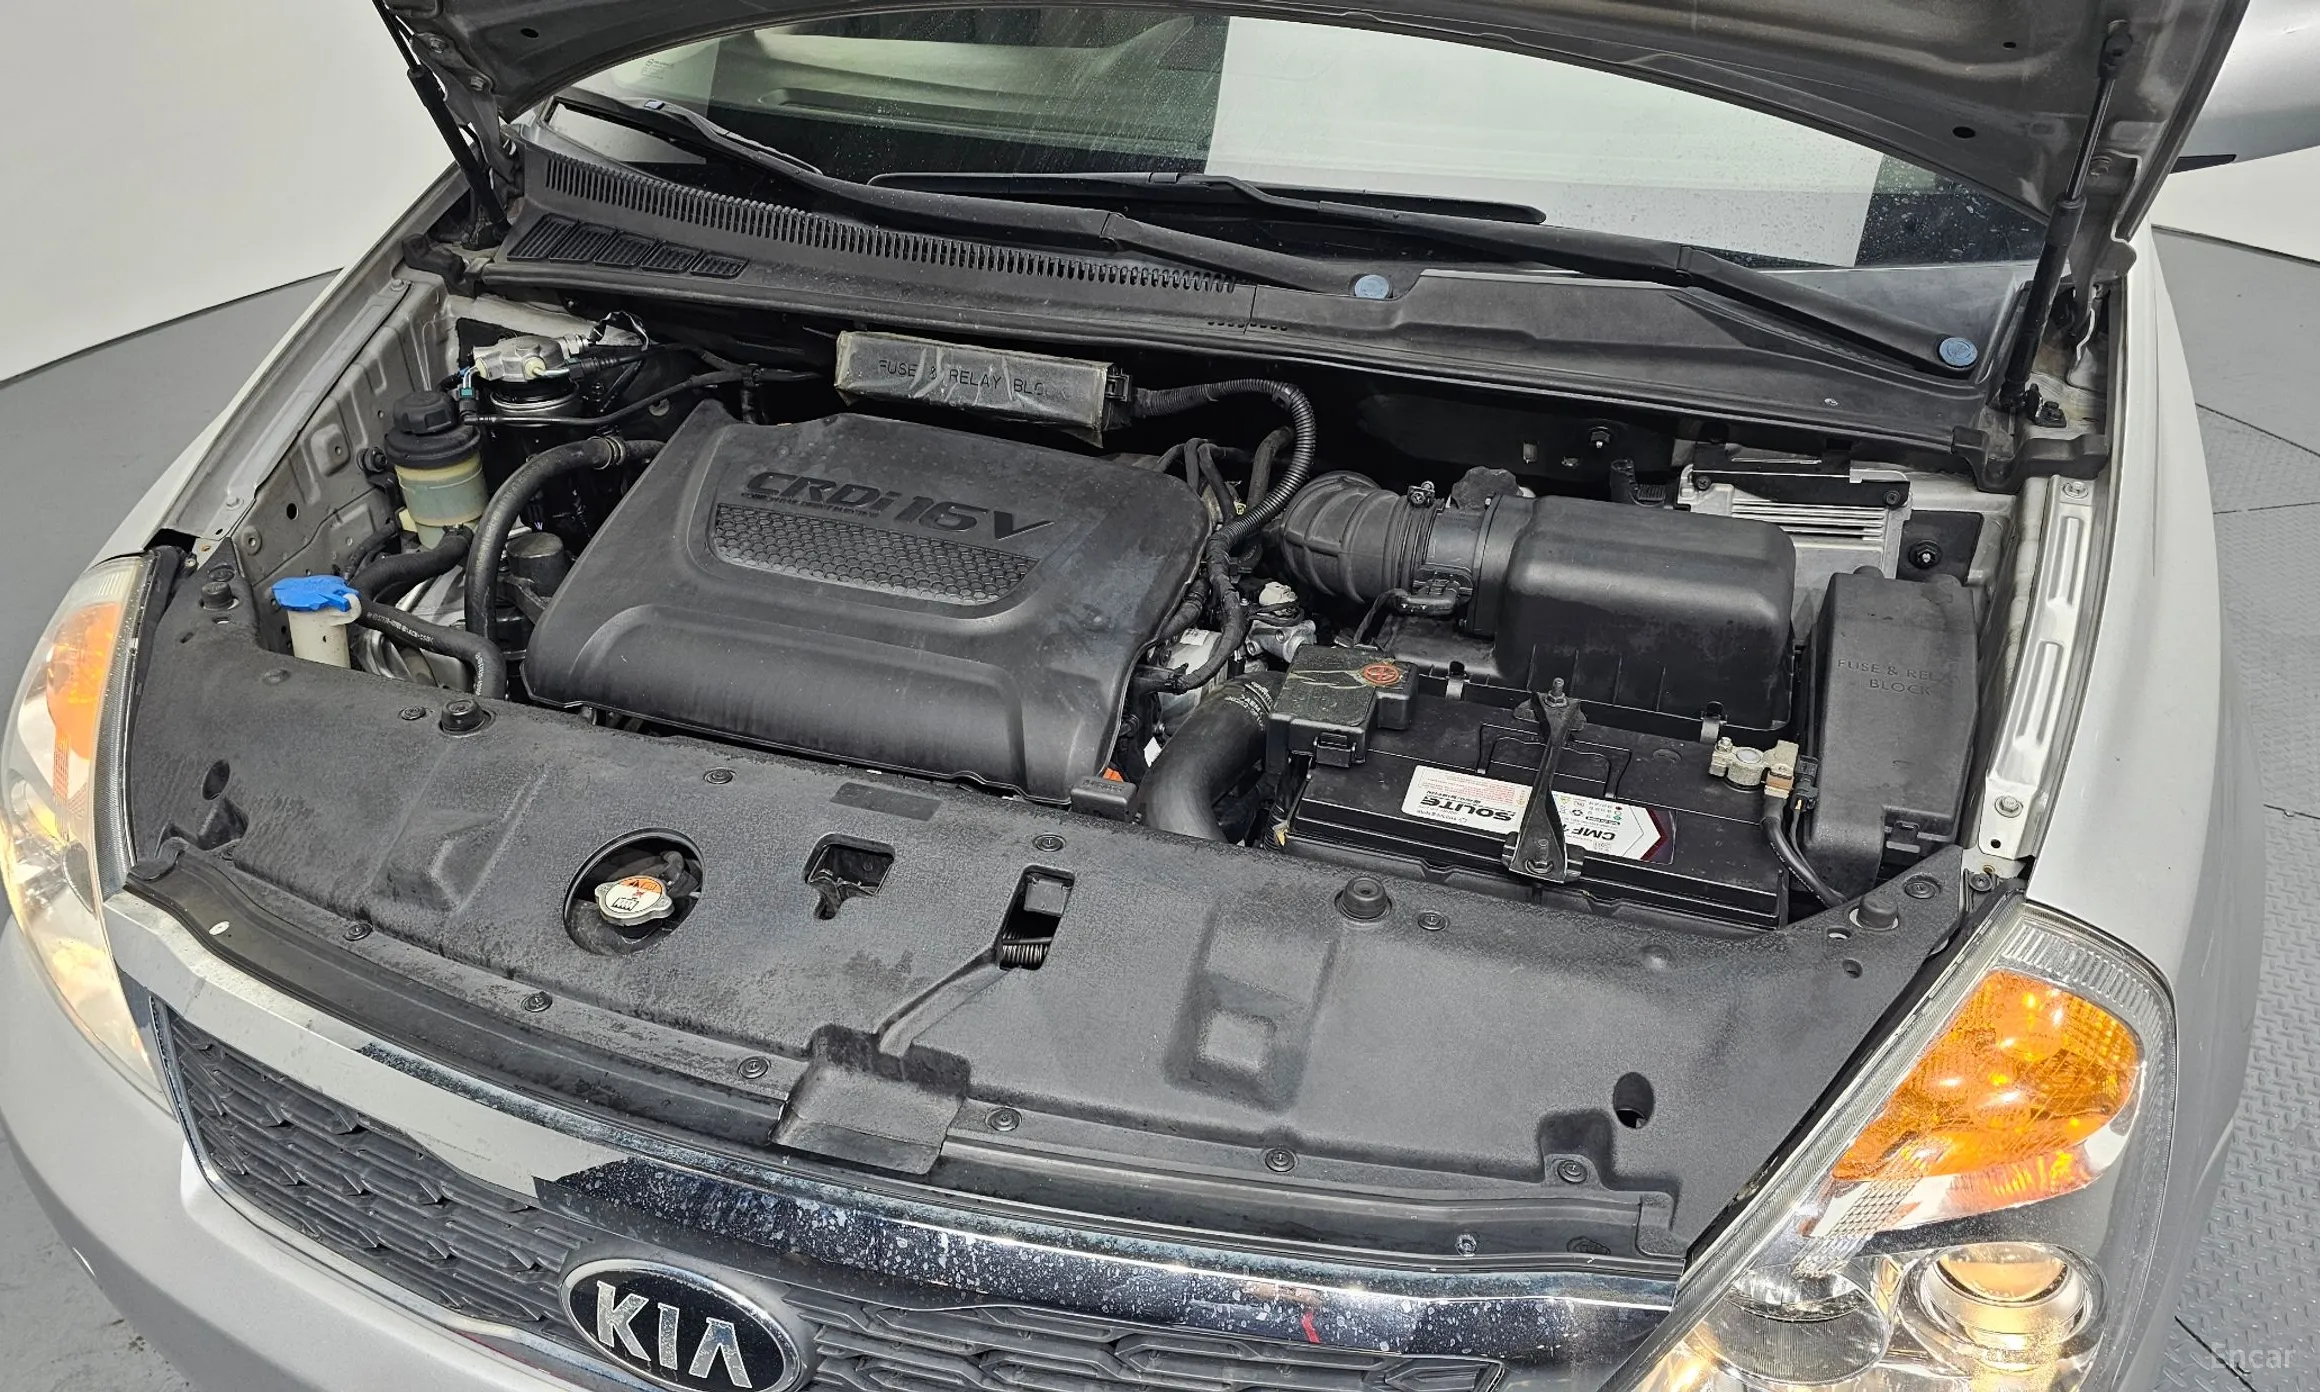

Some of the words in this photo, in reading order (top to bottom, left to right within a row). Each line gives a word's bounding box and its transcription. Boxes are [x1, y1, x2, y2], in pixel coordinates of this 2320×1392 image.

[879, 359, 918, 377] FUSE
[950, 368, 1002, 389] RELAY
[1837, 658, 1880, 674] FUSE
[1886, 665, 1898, 676] &
[1869, 678, 1933, 696] BLOCK
[1420, 796, 1513, 821] SOLITE
[597, 1279, 752, 1388] KIA
